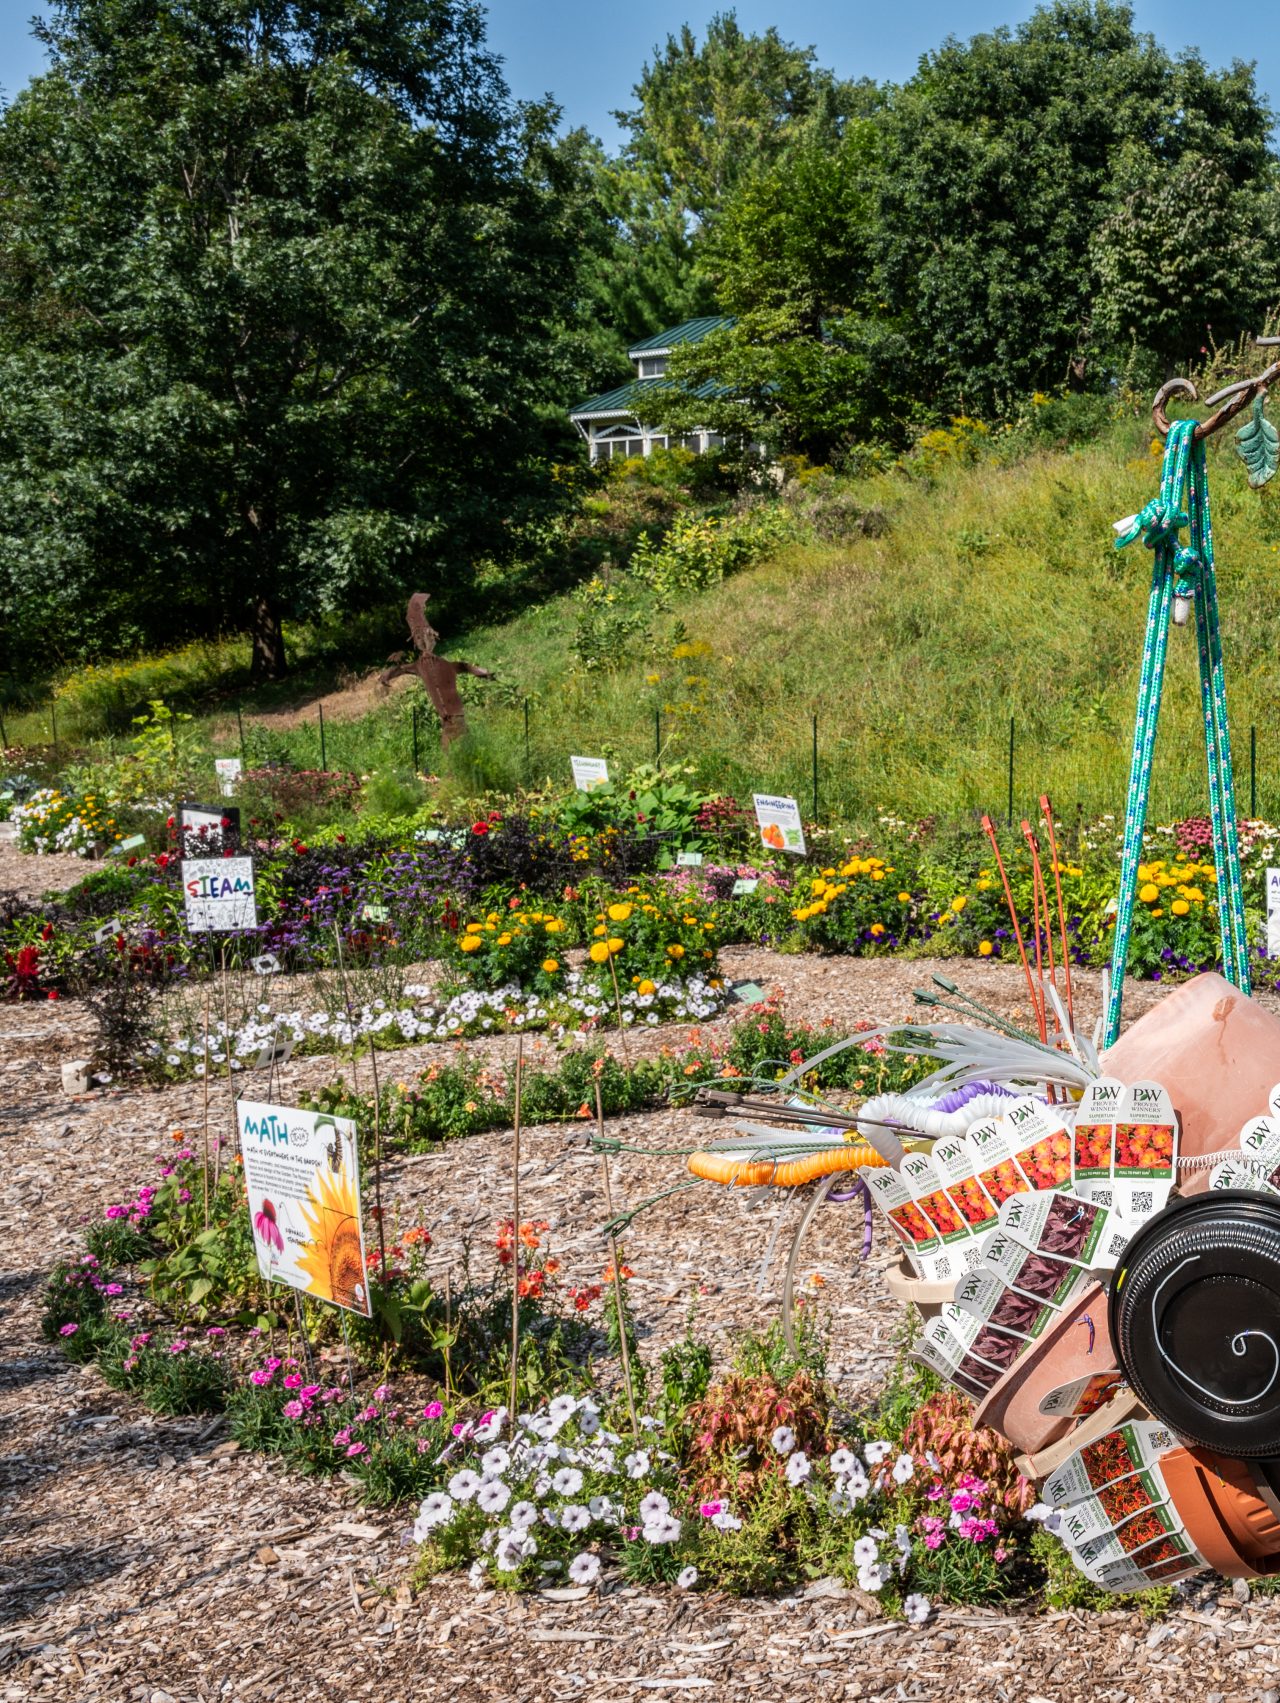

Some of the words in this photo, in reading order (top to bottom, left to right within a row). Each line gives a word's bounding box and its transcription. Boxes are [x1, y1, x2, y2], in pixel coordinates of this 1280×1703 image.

[187, 876, 251, 898] STEAM
[1092, 1087, 1121, 1100] PW
[1133, 1089, 1162, 1101] PW
[1009, 1101, 1036, 1126] PW
[244, 1115, 289, 1146] MATH
[971, 1122, 998, 1146] PW
[1246, 1120, 1270, 1149] PW
[937, 1141, 962, 1161] PW
[904, 1157, 929, 1176] PW
[873, 1172, 896, 1190] PW
[1006, 1199, 1024, 1229] PW
[1020, 1205, 1031, 1229] PROVEN
[1024, 1203, 1037, 1232] WINNERS
[1029, 1221, 1039, 1241] PROVEN
[987, 1233, 1009, 1262] PW
[1003, 1243, 1018, 1267] WINNER
[960, 1274, 982, 1302] PW
[974, 1280, 988, 1302] PROVEN
[947, 1304, 961, 1321] P
[932, 1320, 949, 1344] PW
[1049, 1479, 1067, 1503] PW
[1063, 1474, 1072, 1493] PROVEN
[1065, 1514, 1086, 1540] PW
[1077, 1509, 1090, 1528] PROVEN
[1077, 1542, 1098, 1566] PW
